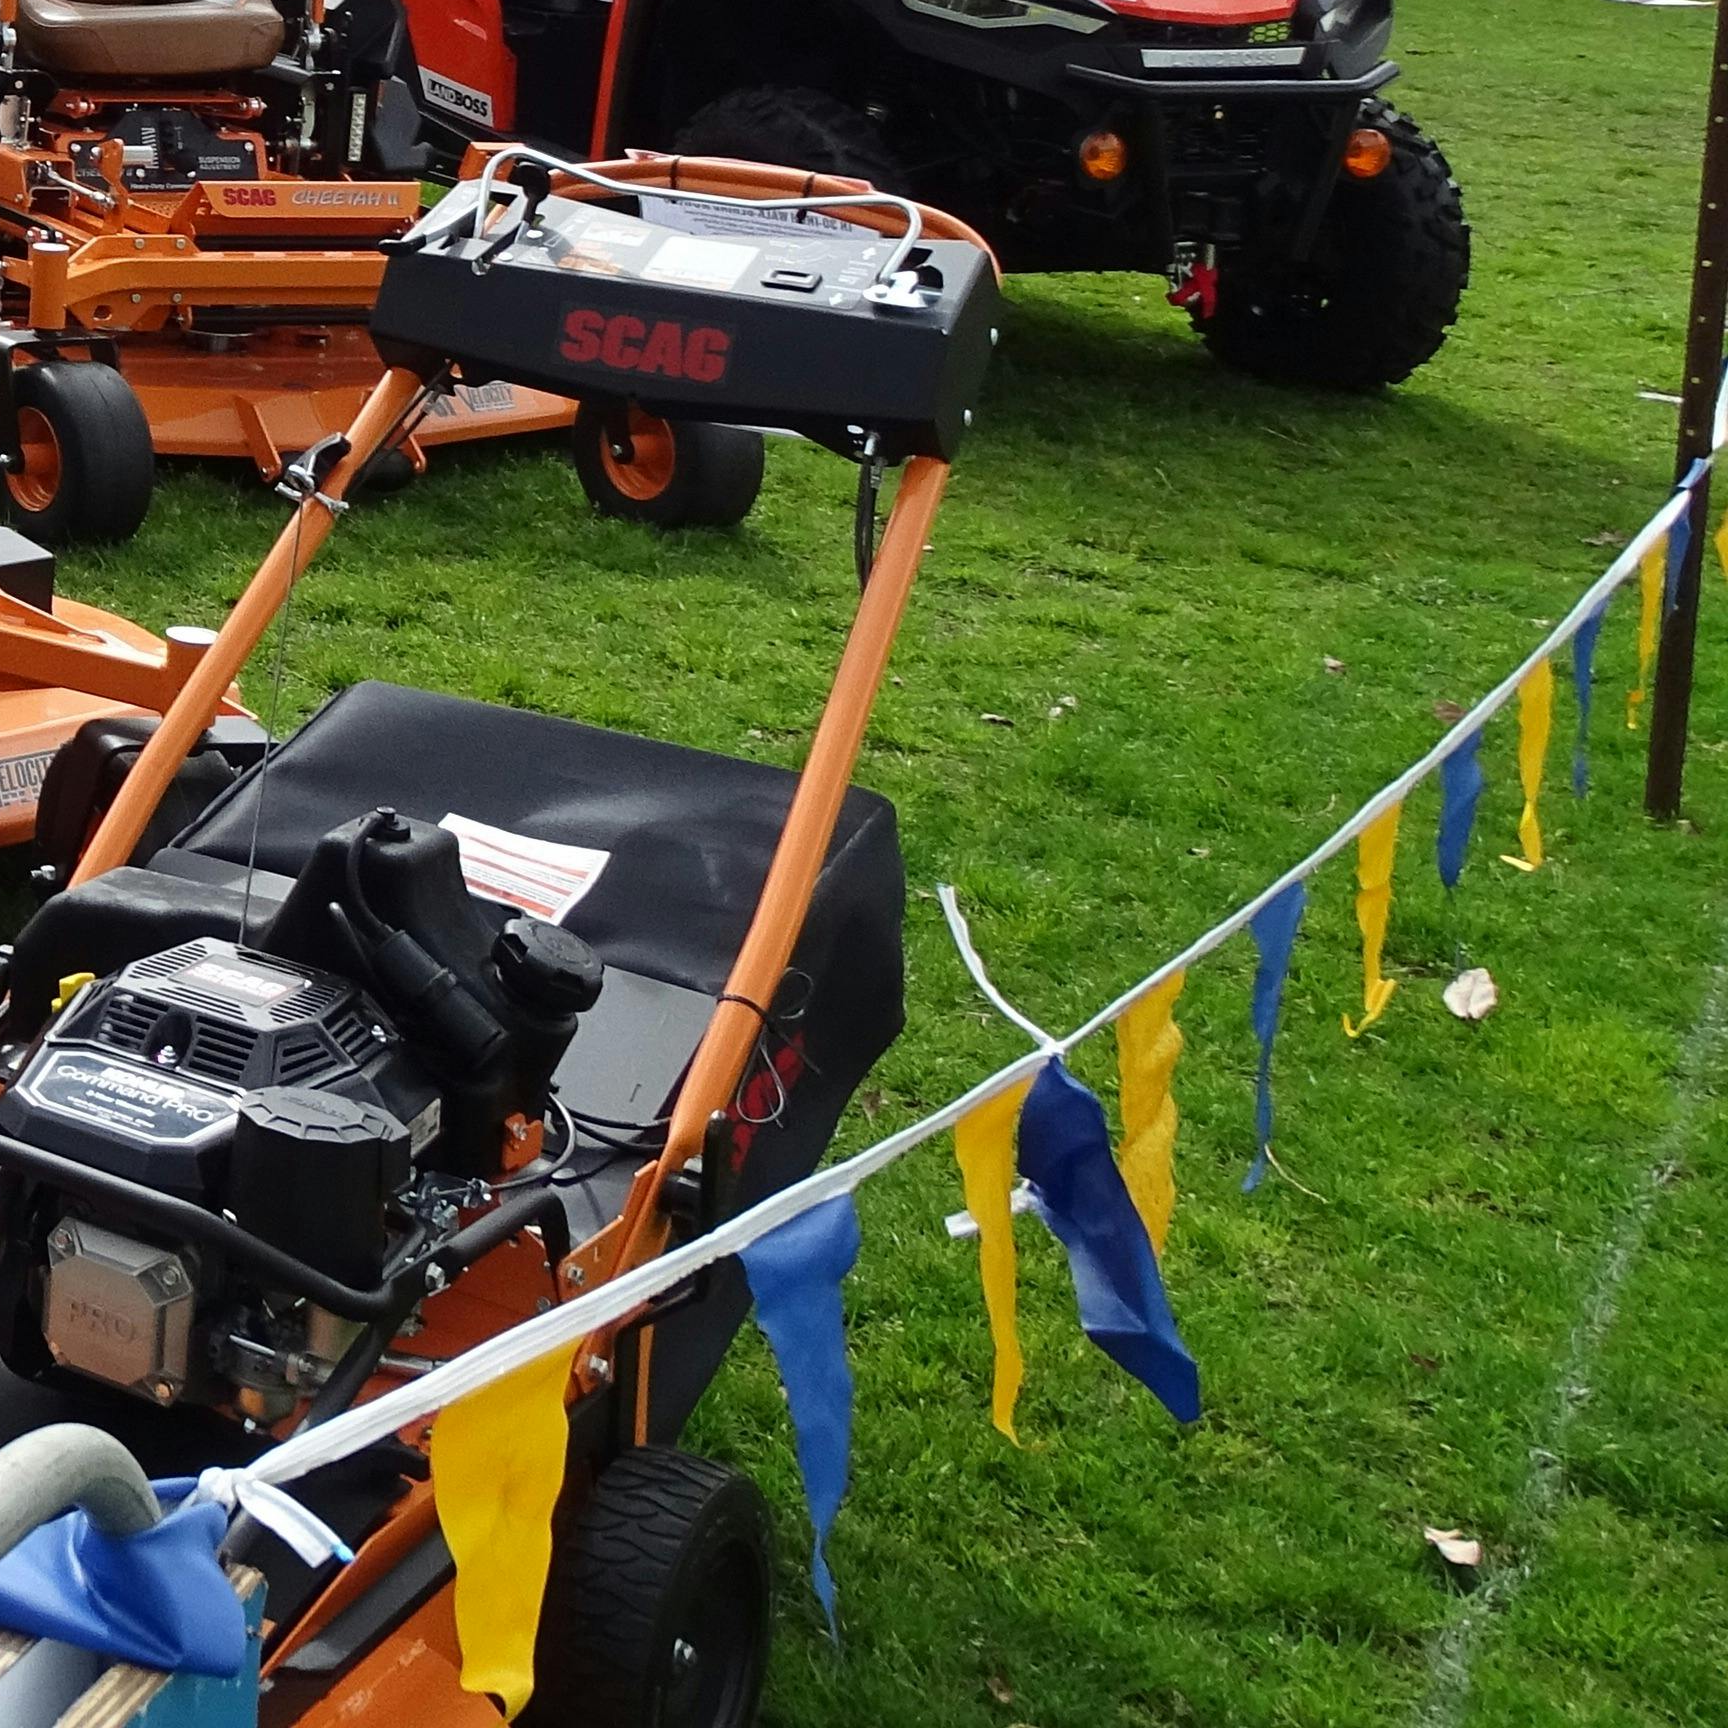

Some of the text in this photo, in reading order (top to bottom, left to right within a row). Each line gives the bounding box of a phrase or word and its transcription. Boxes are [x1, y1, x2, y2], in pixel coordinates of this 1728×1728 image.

[426, 77, 488, 118] LANDBOSS
[197, 155, 242, 164] SUSPENSION
[198, 163, 242, 171] ADJUSTMENT
[222, 188, 401, 207] SCAG CHEETAH II
[559, 307, 731, 384] SCAG
[56, 1064, 162, 1106] Command
[161, 1099, 215, 1124] PRO
[66, 1299, 139, 1343] PRO
